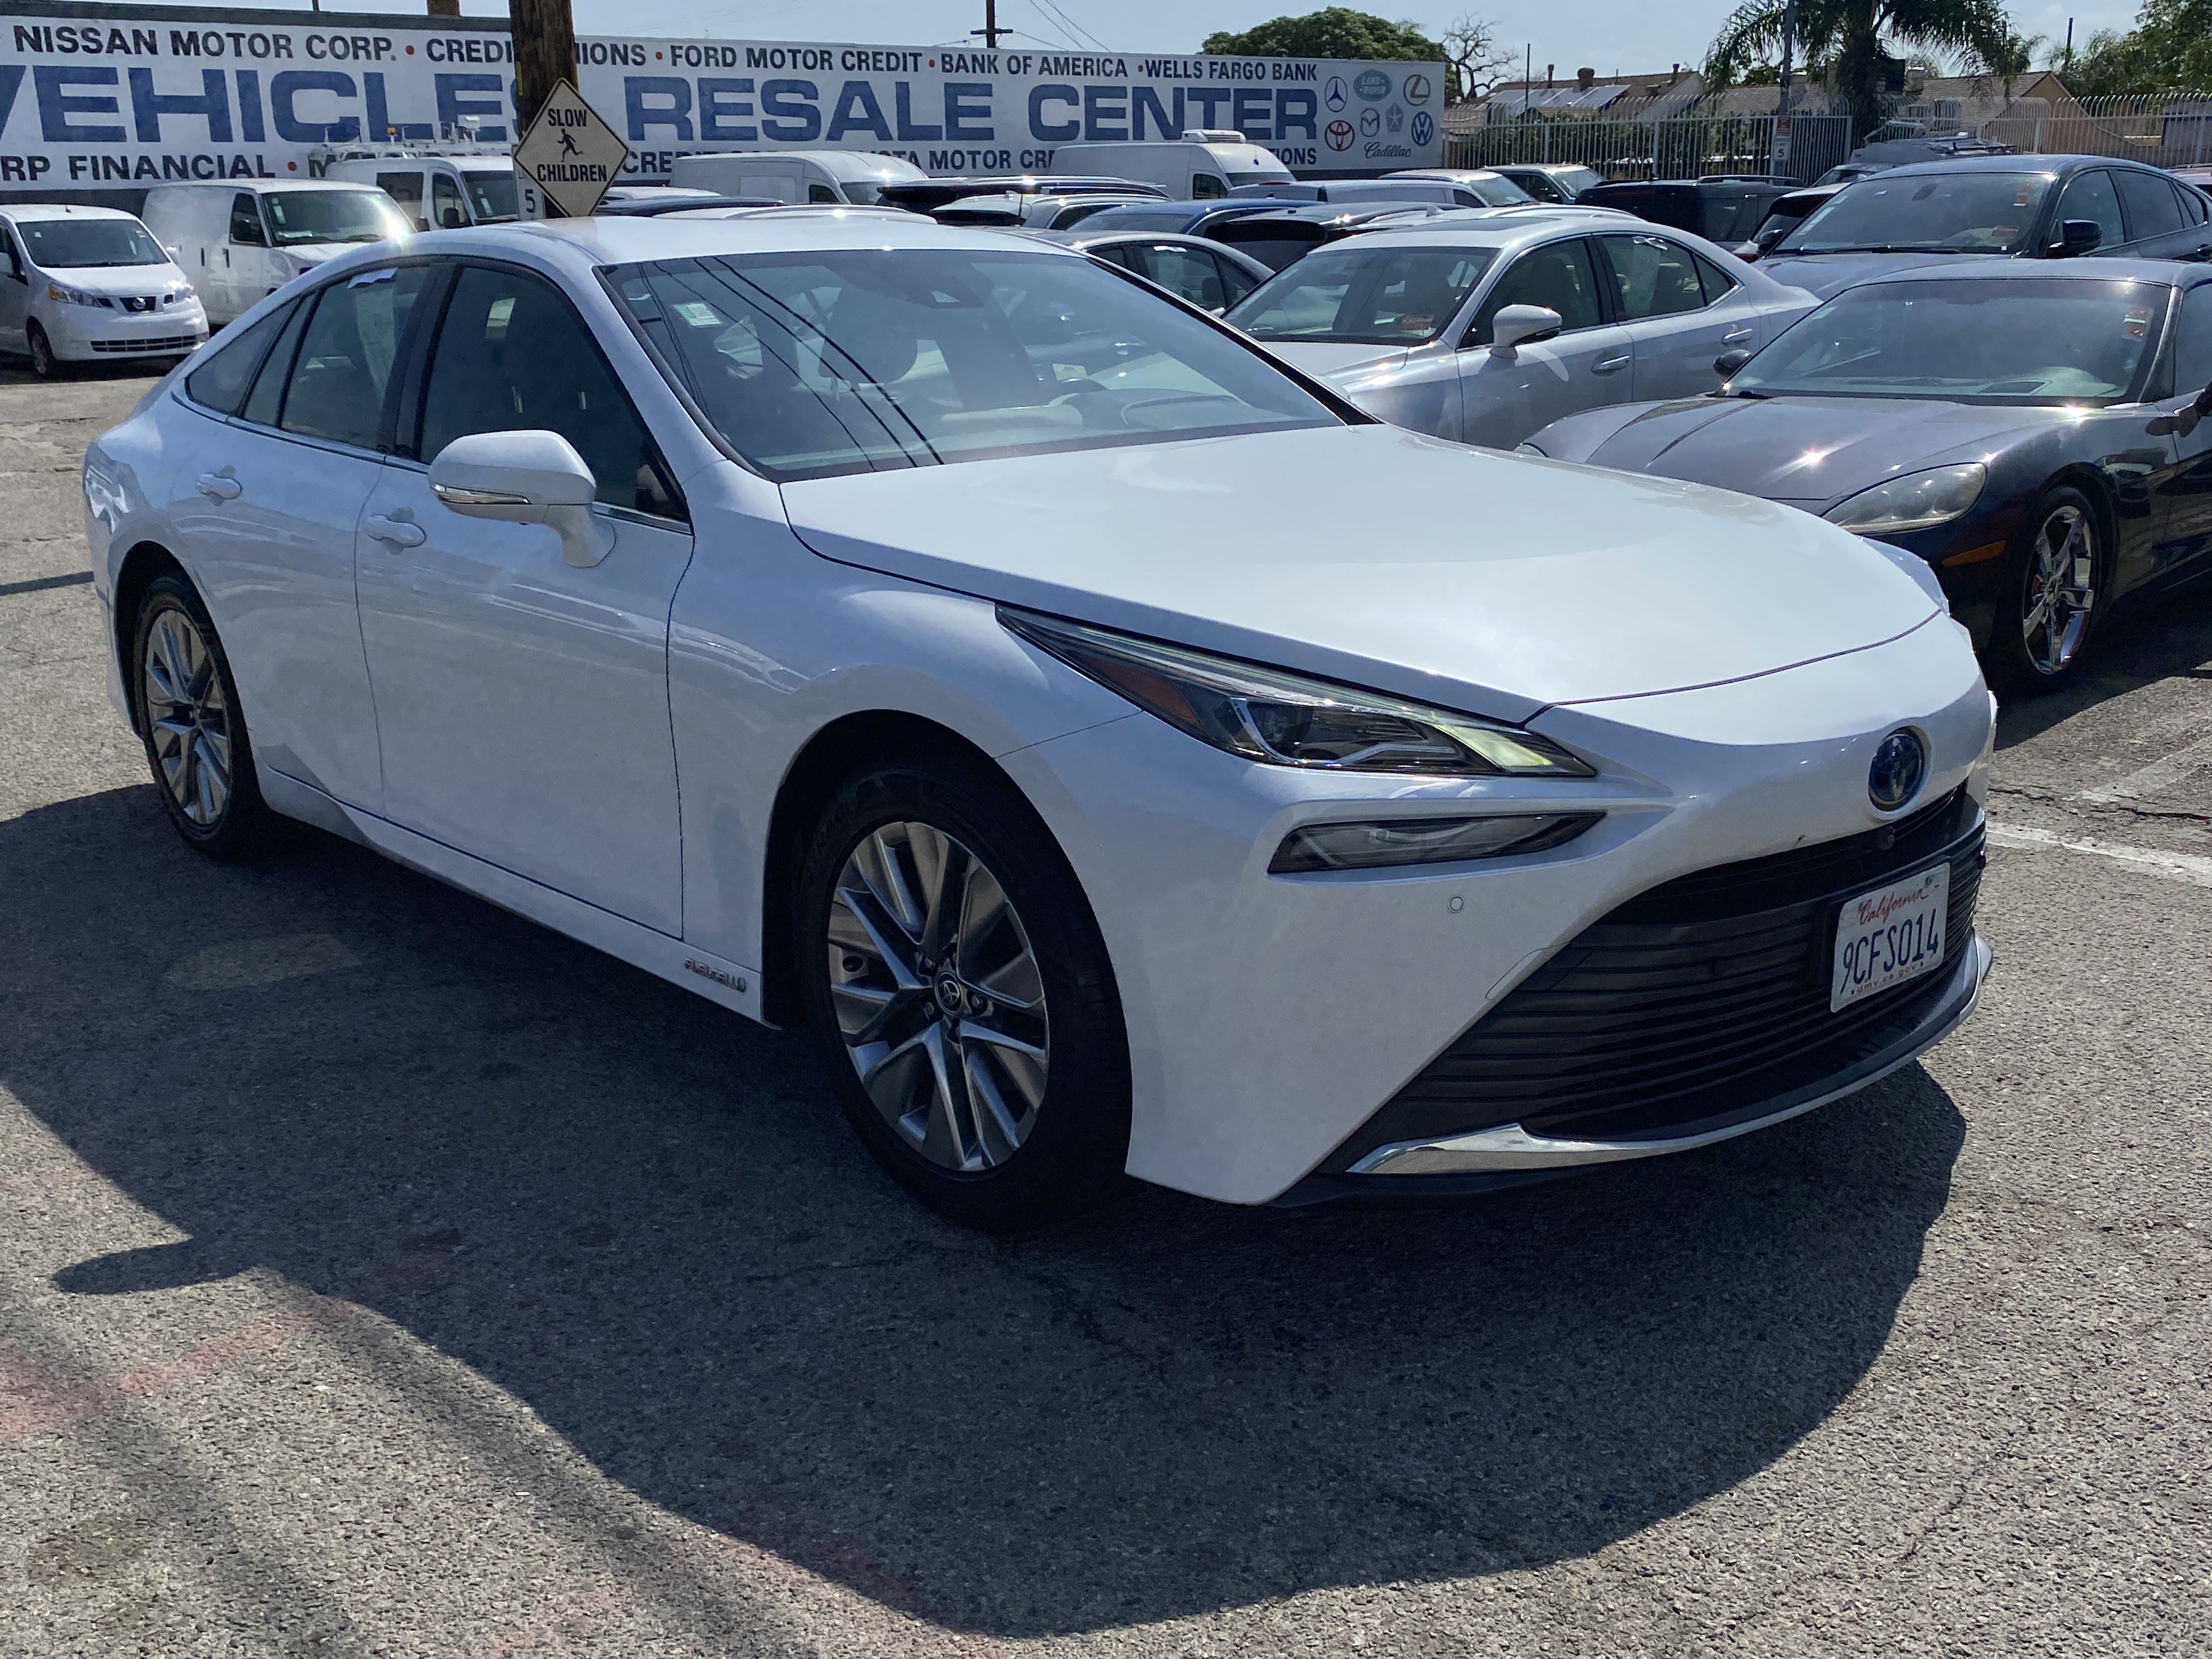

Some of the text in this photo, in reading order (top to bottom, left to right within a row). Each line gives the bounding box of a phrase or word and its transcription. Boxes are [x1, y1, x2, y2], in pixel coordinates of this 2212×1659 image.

[13, 25, 396, 61] NISSAN MOTOR CORP.
[426, 38, 512, 63] CREDI
[670, 45, 923, 72] FORD MOTOR CREDIT
[941, 53, 1128, 77] BANK OF AMERICA
[1145, 59, 1318, 81] WELLS FARGO BANK
[0, 64, 1317, 143] EHICLE RESALE CENTER
[548, 108, 587, 127] SLOW
[929, 150, 1011, 170] MOTOR
[1363, 141, 1412, 159] Cadillac
[1778, 149, 1784, 157] 5
[69, 154, 275, 180] FINANCIAL
[537, 163, 607, 182] CHILDREN
[524, 188, 536, 213] 5
[1858, 888, 1929, 926] California
[1840, 908, 1939, 995] 9CFS014
[1857, 963, 1917, 993] dmv.ca.gov
